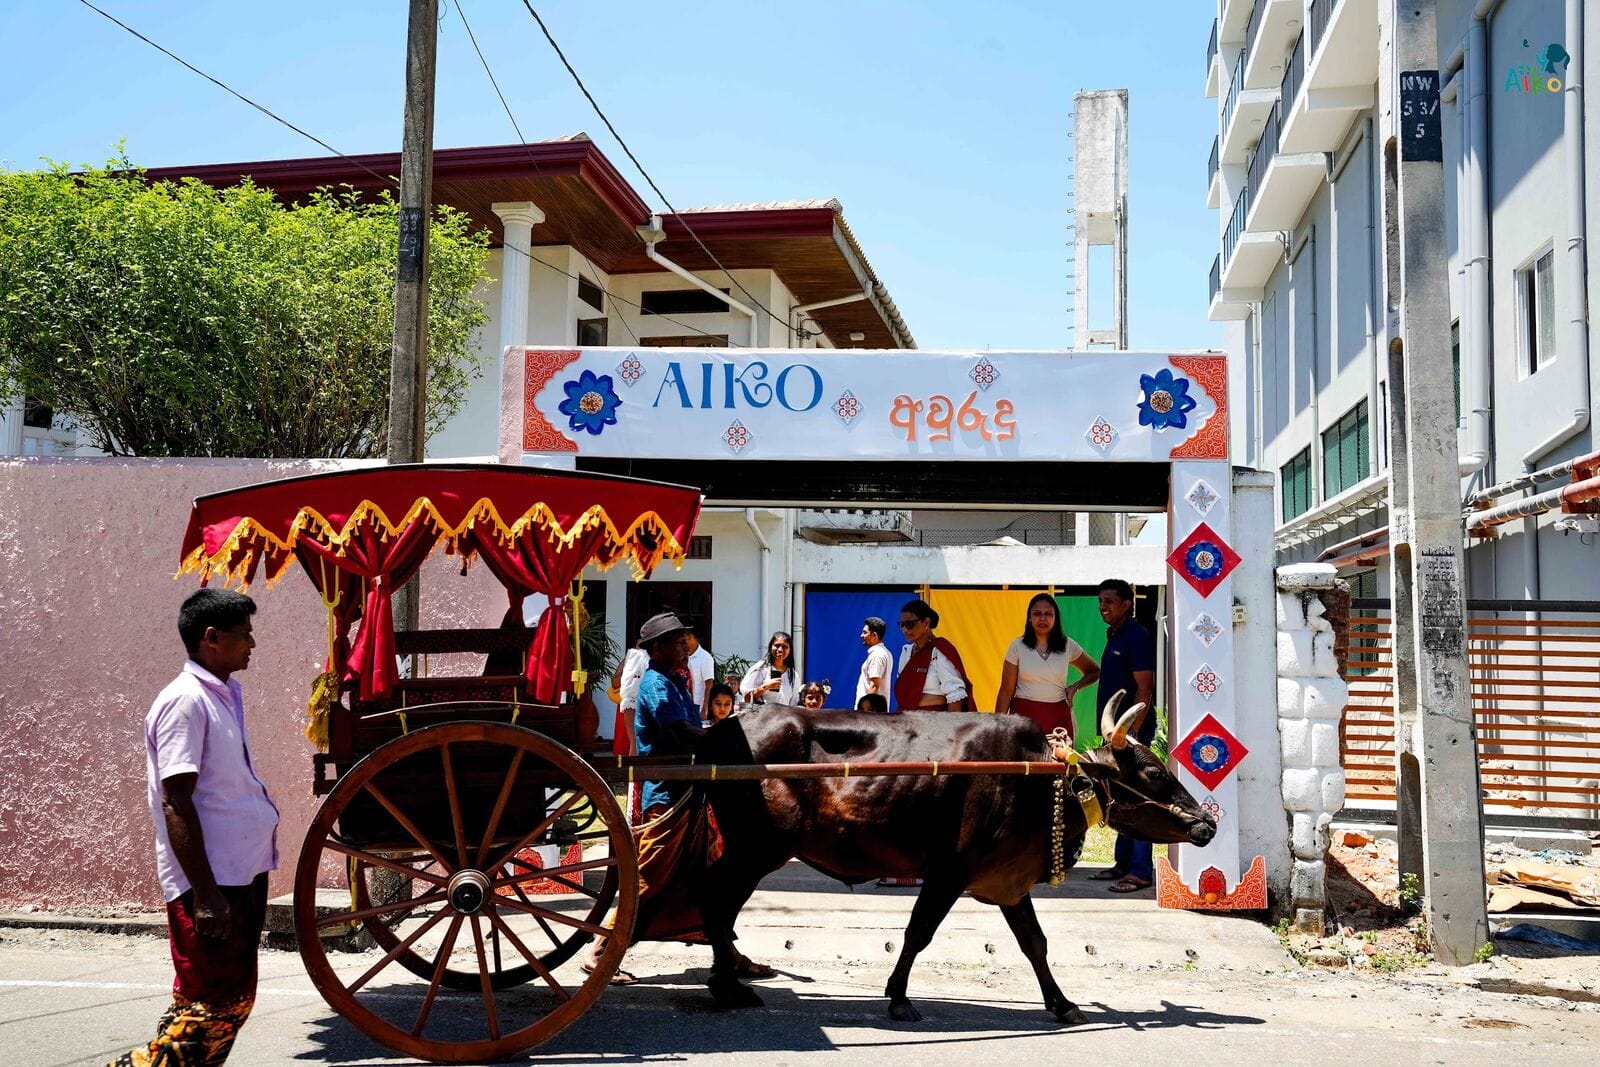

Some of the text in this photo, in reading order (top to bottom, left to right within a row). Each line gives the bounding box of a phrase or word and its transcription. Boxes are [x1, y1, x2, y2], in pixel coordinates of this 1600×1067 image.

[1402, 75, 1432, 91] NW
[1415, 123, 1426, 138] 5
[652, 361, 823, 411] AIKO
[889, 390, 1017, 443] අවුරුදු
